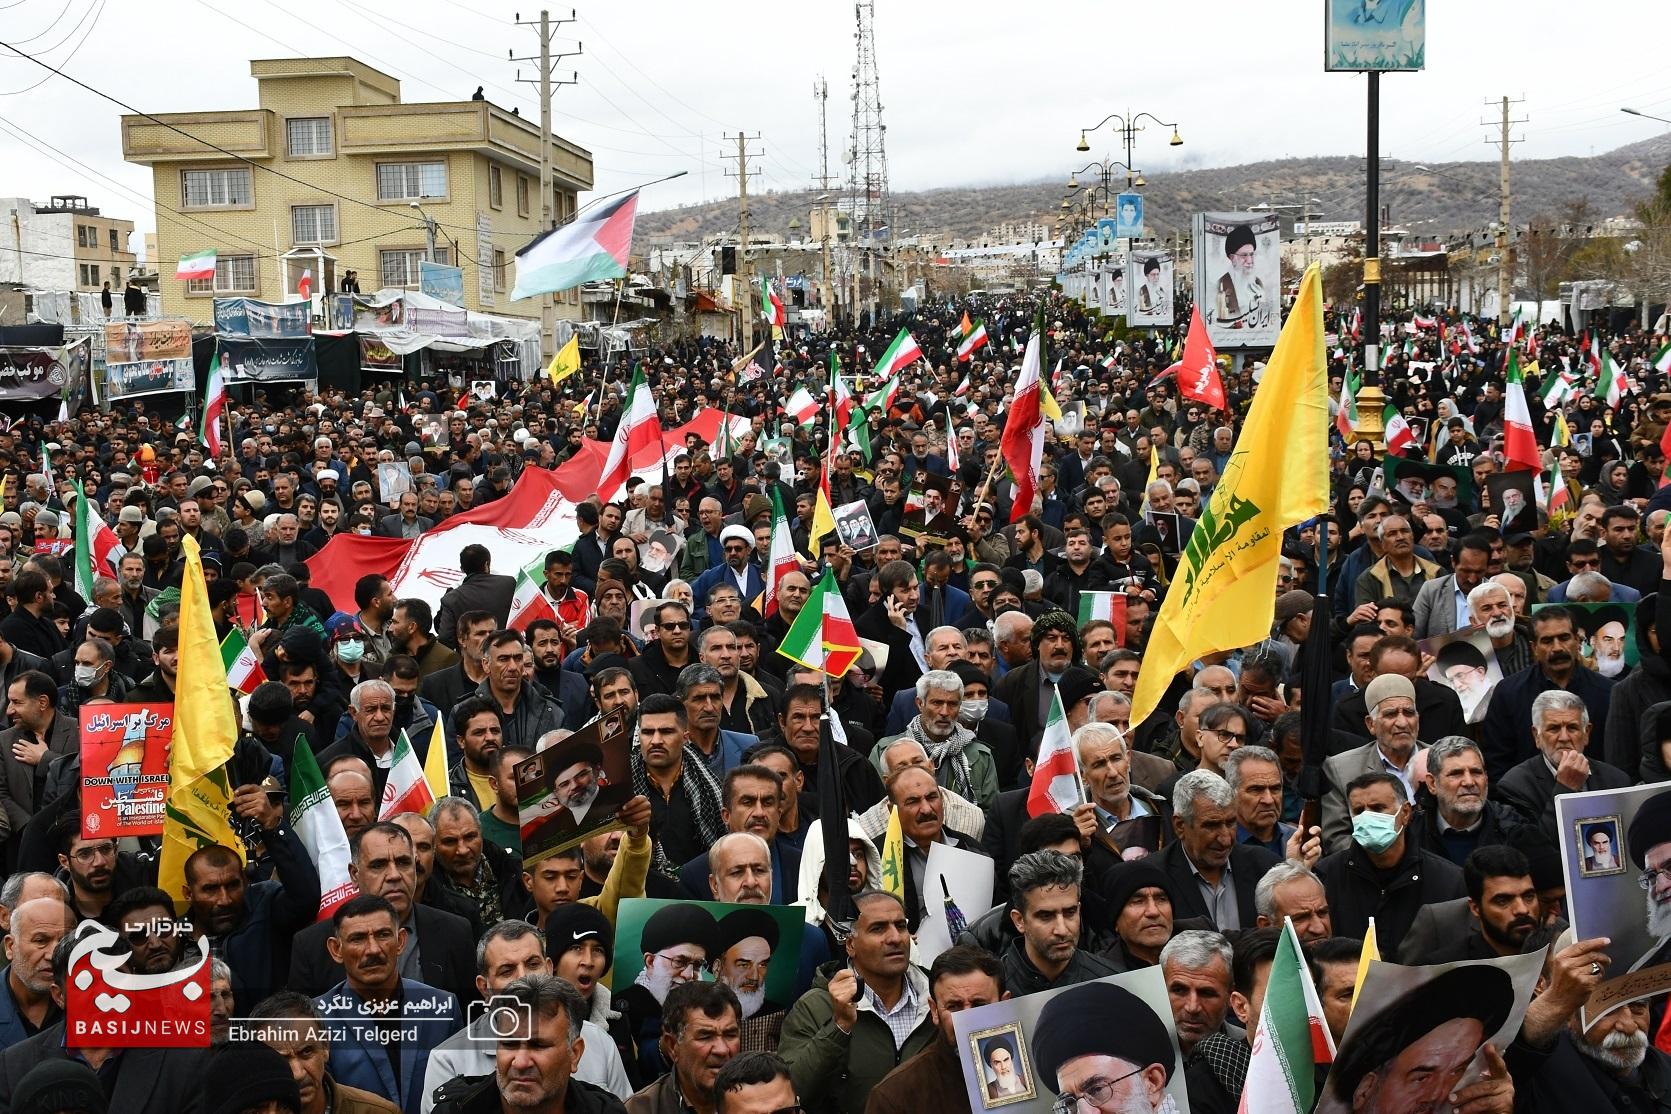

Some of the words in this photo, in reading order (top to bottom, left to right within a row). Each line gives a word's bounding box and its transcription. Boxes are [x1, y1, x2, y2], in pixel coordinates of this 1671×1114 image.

[1248, 308, 1270, 329] ایران
[16, 361, 44, 381] موکب
[86, 713, 130, 732] اسرائیل
[130, 717, 143, 731] بر
[144, 712, 171, 730] مرگ
[84, 777, 113, 786] DOWN
[115, 775, 140, 785] WITH
[100, 788, 164, 810] فلسطین
[117, 802, 166, 816] Palestine
